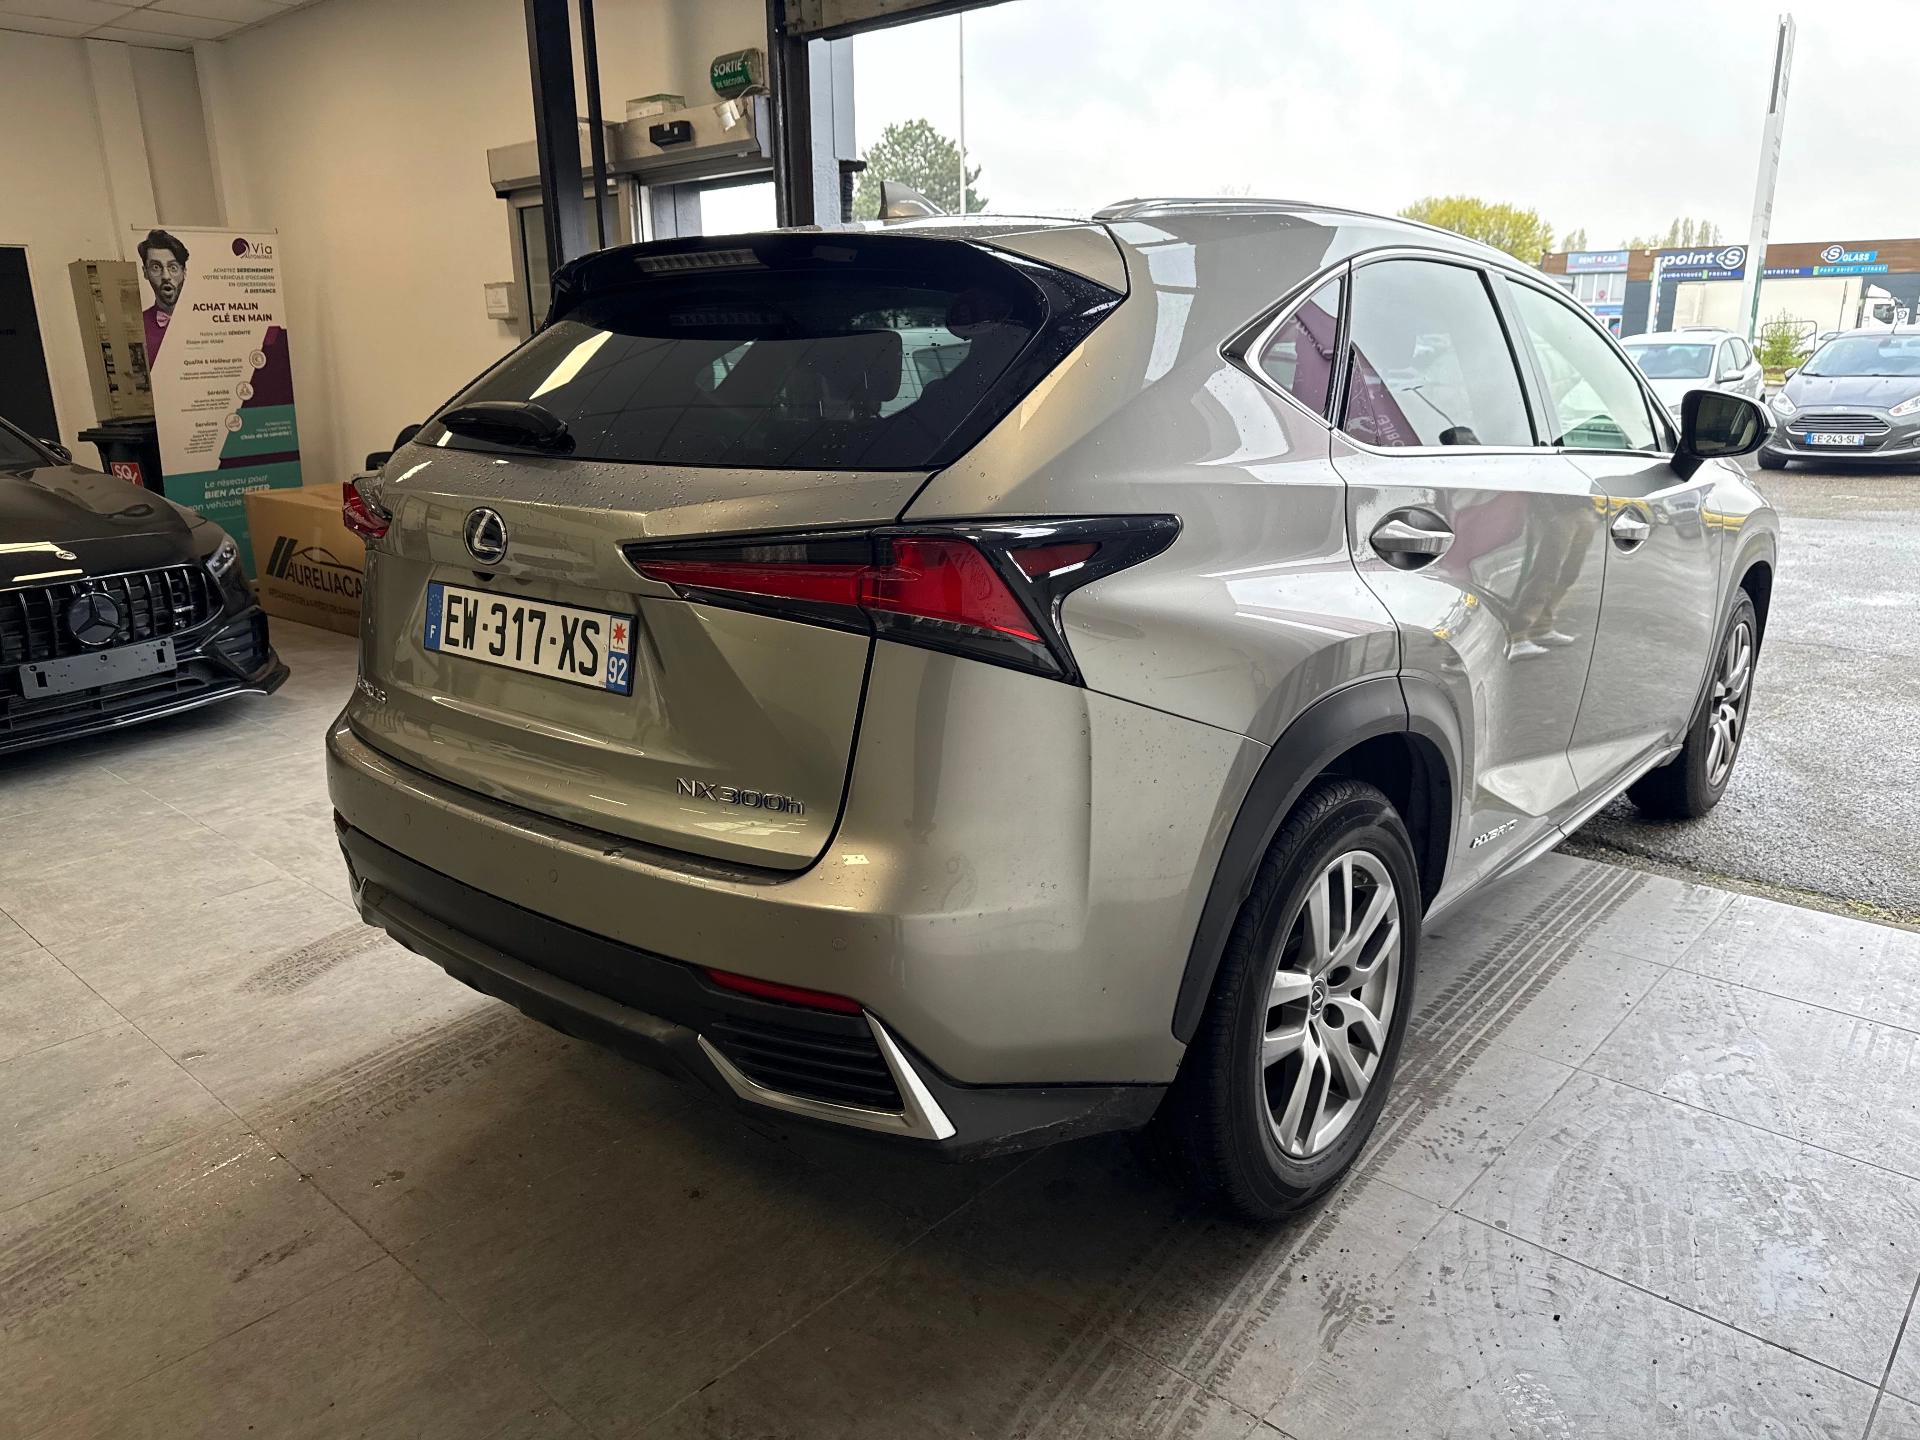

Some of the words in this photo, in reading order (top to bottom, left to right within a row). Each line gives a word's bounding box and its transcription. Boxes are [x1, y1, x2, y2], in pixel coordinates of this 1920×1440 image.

[713, 59, 742, 77] SORTIE
[251, 243, 273, 254] Via
[1602, 255, 1618, 263] CAR
[1661, 251, 1715, 267] point
[1842, 253, 1870, 261] GLASS
[192, 303, 226, 311] ACHAT
[228, 302, 259, 311] MALIN
[212, 312, 231, 323] CLÉ
[233, 314, 246, 322] EN
[248, 313, 273, 322] MAIN
[204, 481, 215, 489] Le
[248, 475, 268, 485] pour
[204, 489, 227, 499] BIEN
[228, 484, 271, 497] ACHETER
[429, 624, 437, 639] F
[444, 594, 600, 677] EW-317-XS
[608, 656, 628, 686] 92
